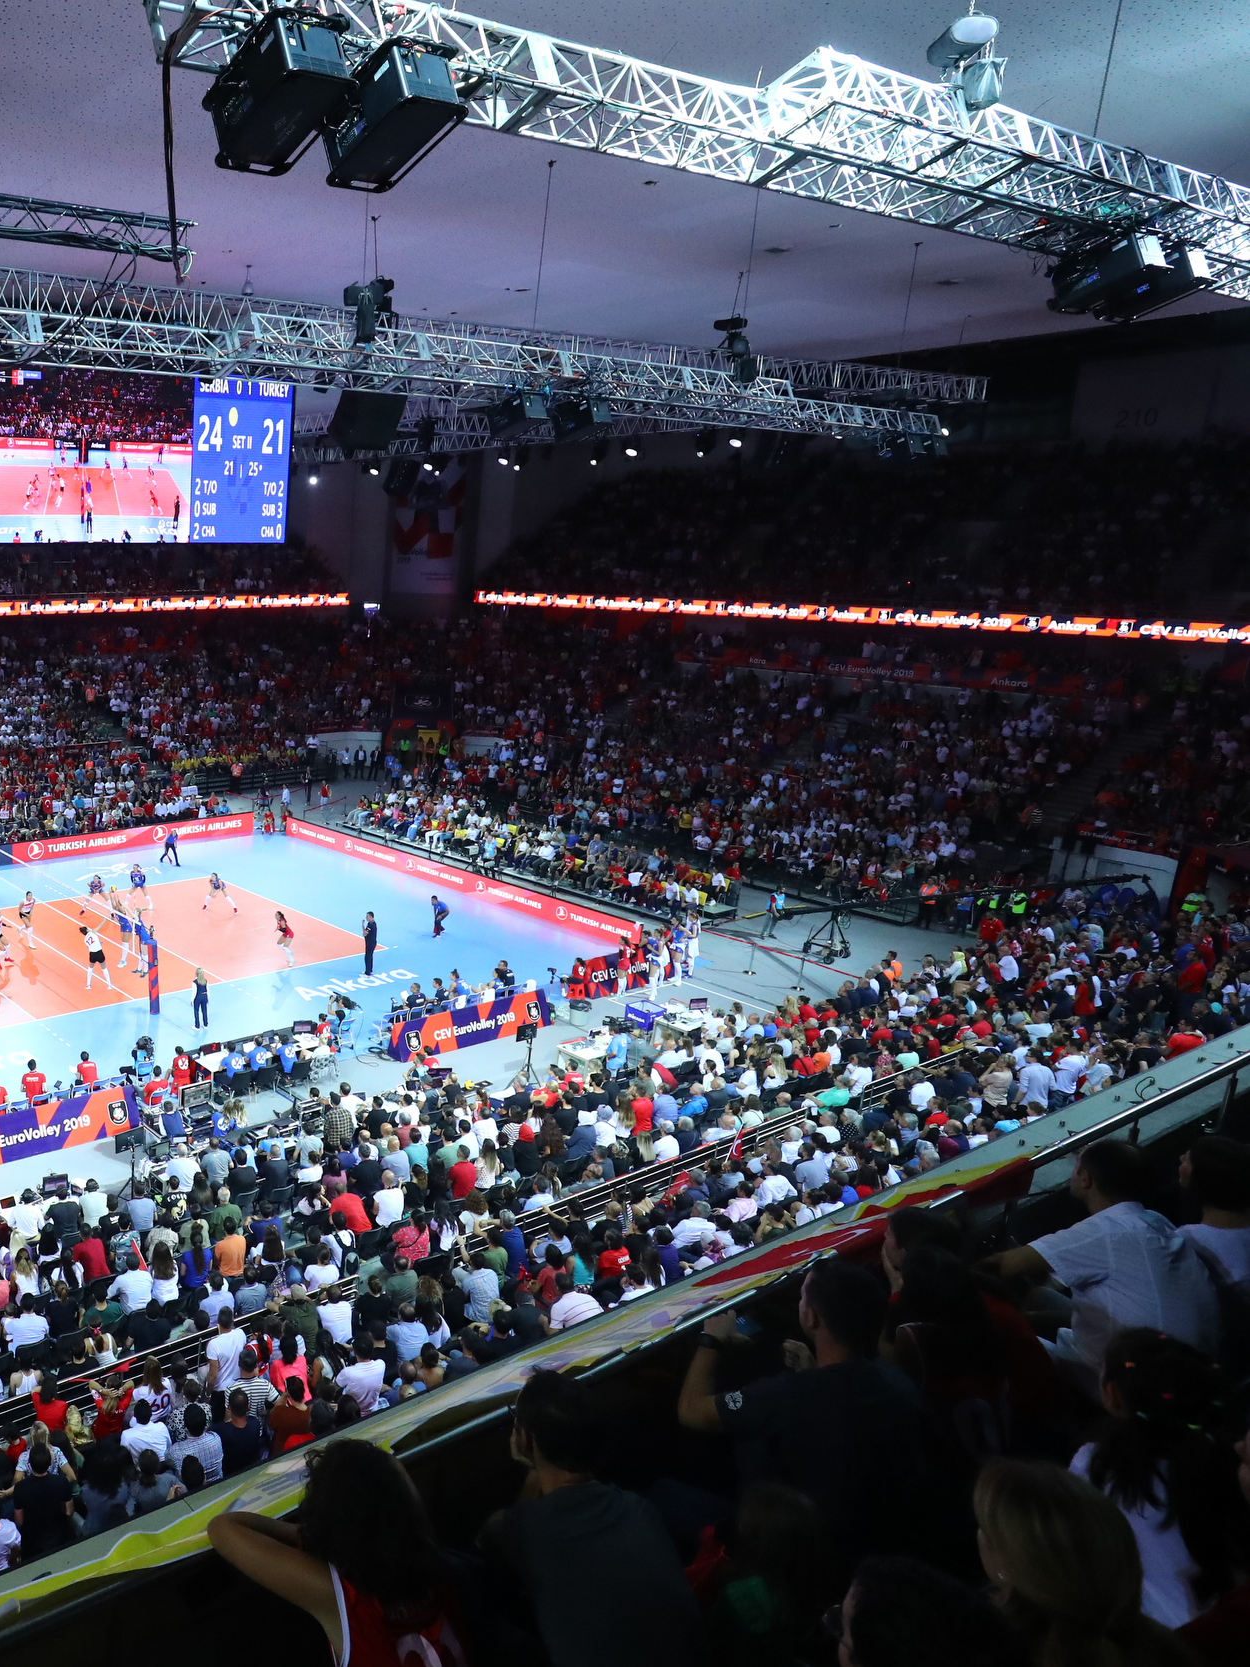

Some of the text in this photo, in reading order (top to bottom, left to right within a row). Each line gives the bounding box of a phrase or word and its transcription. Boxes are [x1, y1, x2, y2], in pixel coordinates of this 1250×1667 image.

[236, 380, 242, 394] 0
[248, 382, 252, 395] 1
[259, 382, 290, 398] TURKEY
[1114, 408, 1159, 429] 210
[198, 415, 284, 455] 24 21
[232, 435, 246, 449] SET
[224, 460, 234, 476] 21
[194, 478, 218, 496] 2 T/O
[263, 481, 284, 497] T/O 2
[194, 501, 217, 518] 0 SUB
[262, 502, 282, 518] SUB 3
[193, 523, 200, 540] 2
[201, 526, 216, 538] CHA
[260, 524, 282, 540] CHA 0
[111, 601, 135, 610] Ankara
[679, 602, 705, 612] Ankara
[727, 605, 808, 618] CEV EuroVolley 2019
[832, 609, 865, 620] Ankara
[895, 613, 1012, 628] CEV EuroVolley 2019
[1048, 620, 1096, 632] Ankara
[1140, 624, 1171, 636] CEV
[828, 663, 914, 678] CEV EuroVolley 2019
[990, 677, 1028, 688] Ankara
[208, 819, 242, 832] AIRLINES
[299, 827, 336, 844] TURKISH AIRLINES
[48, 835, 126, 853] TURKISH AIRLINES
[354, 844, 396, 863] TURKISH AIRLINES
[416, 864, 464, 885] TURKISH AIRLINES
[488, 887, 542, 910] TURKISH AIRLINES
[570, 913, 632, 938] TURKISH AIRLINES
[86, 936, 94, 946] 12
[592, 970, 609, 982] CEV
[294, 967, 419, 1002] Ankara
[434, 1012, 516, 1041] CEV EuroVolley 2019
[64, 1114, 91, 1132] 2019
